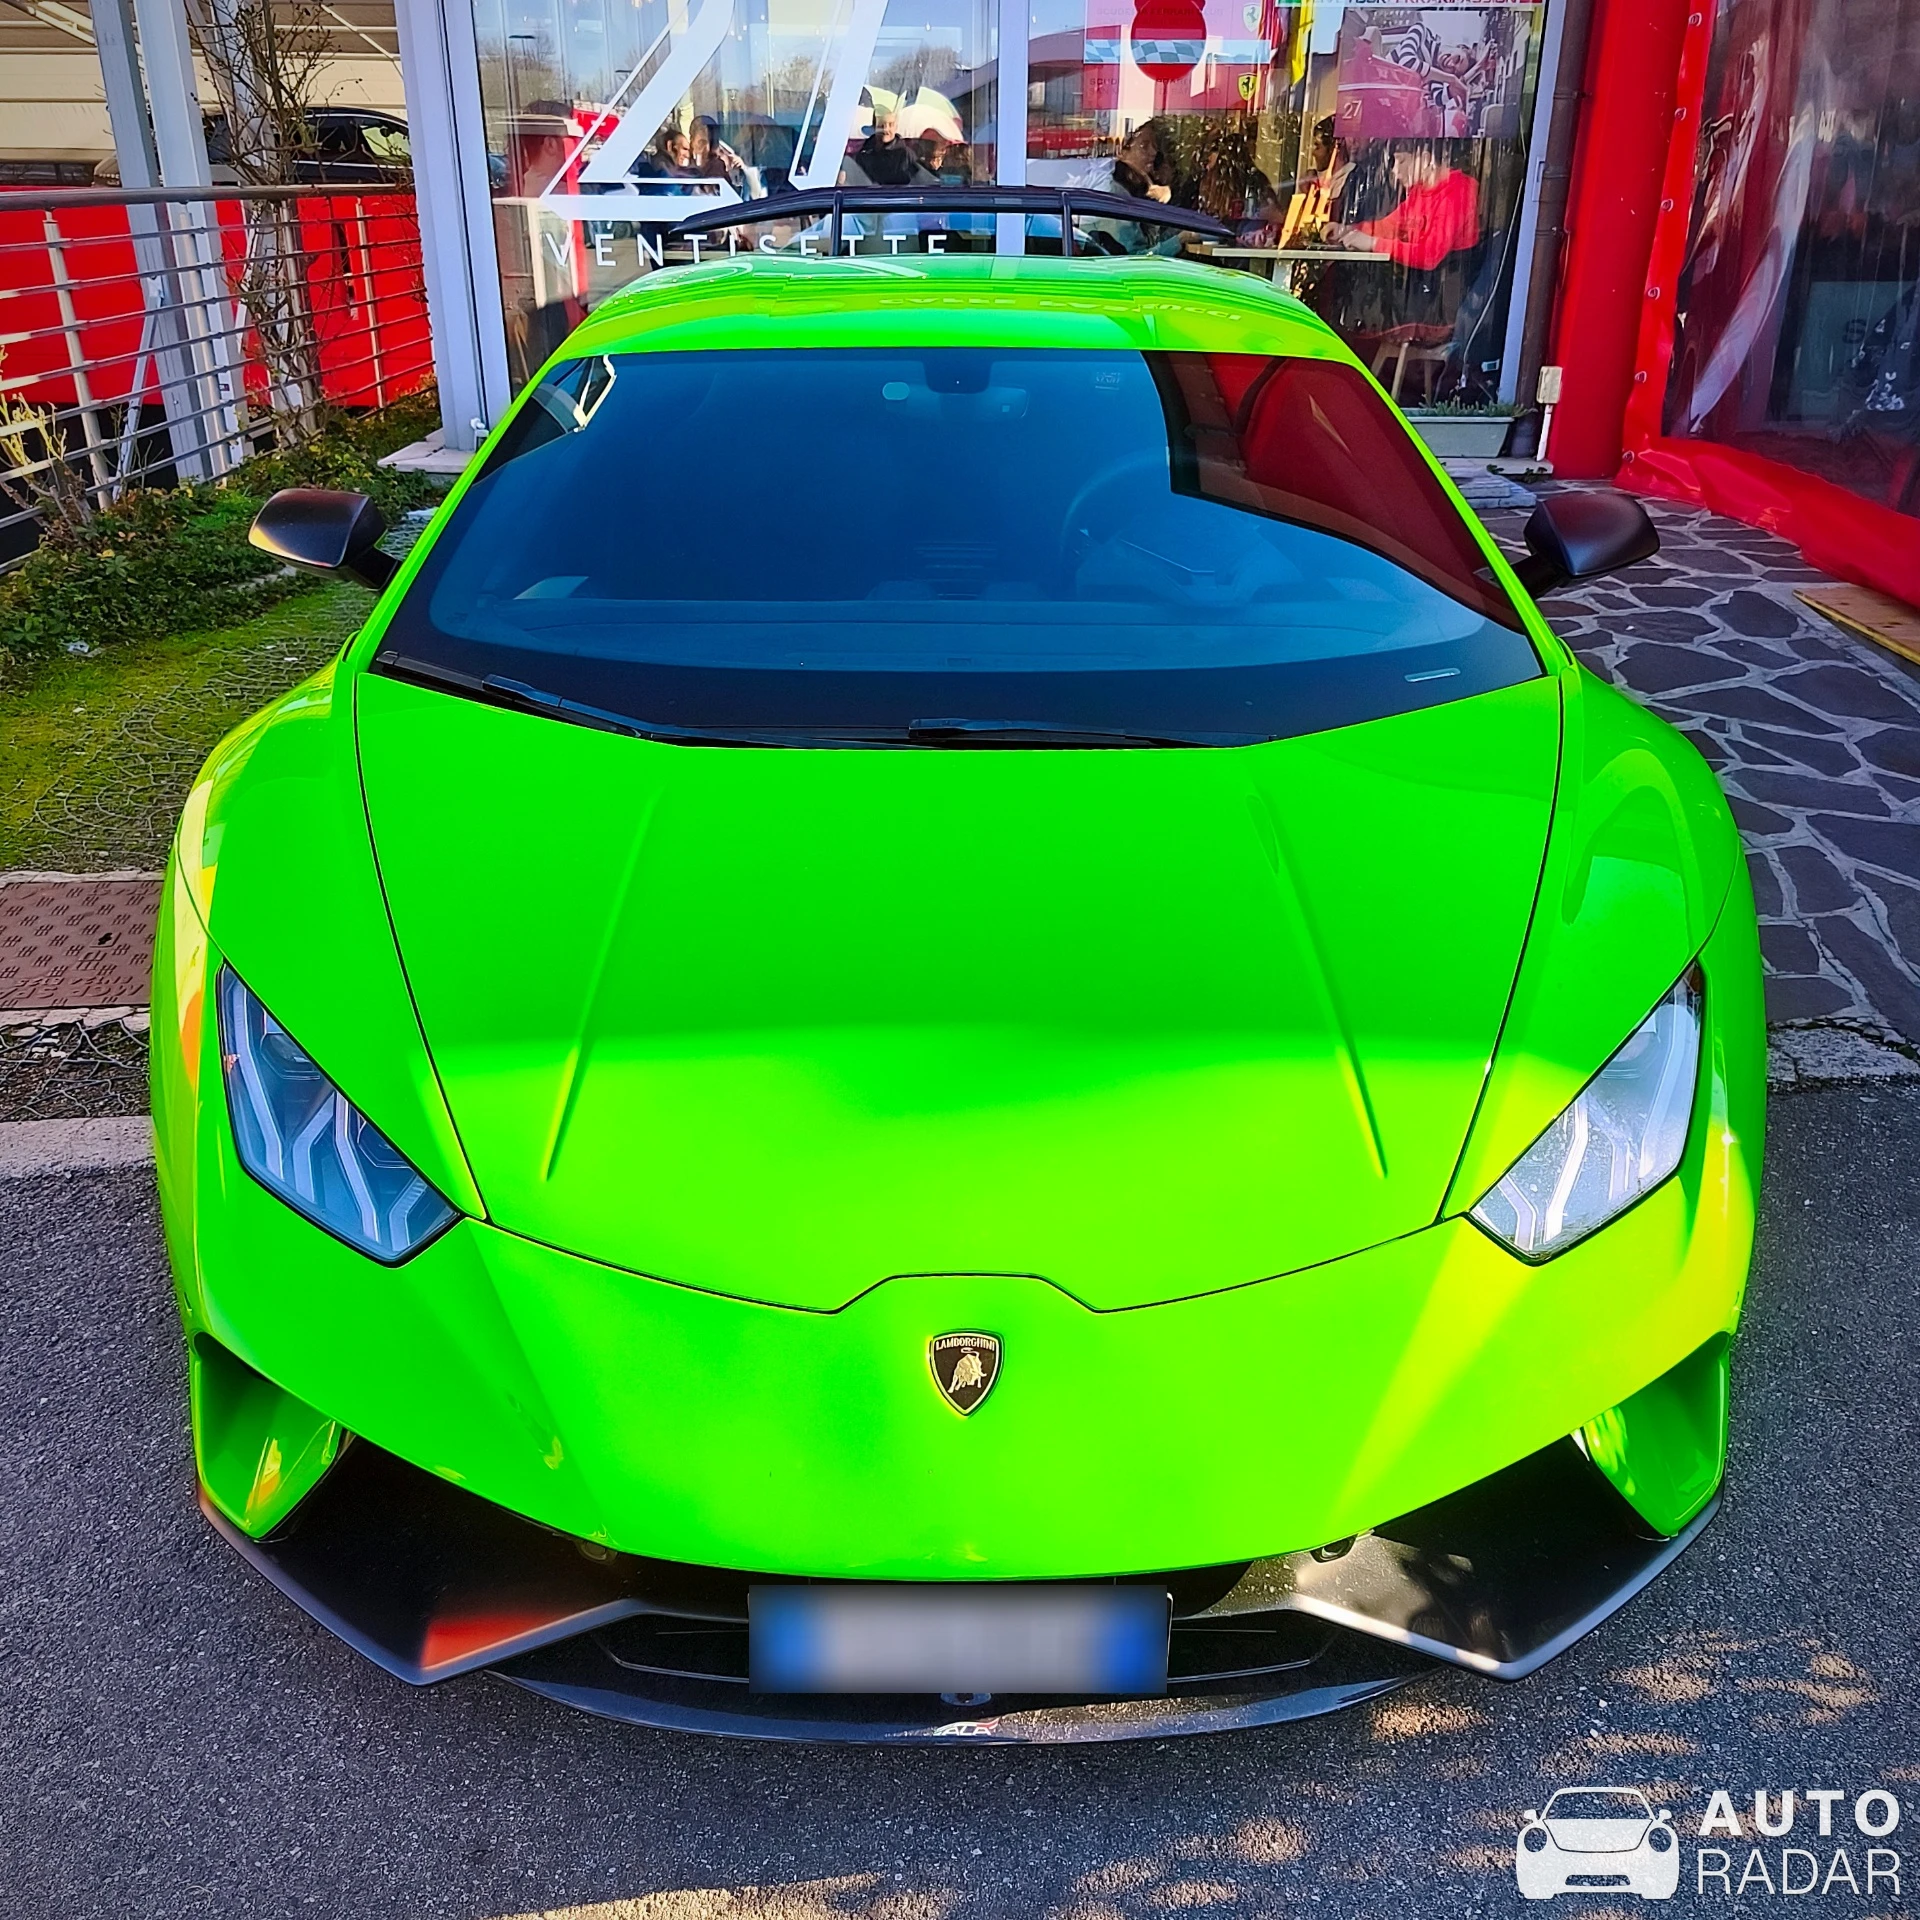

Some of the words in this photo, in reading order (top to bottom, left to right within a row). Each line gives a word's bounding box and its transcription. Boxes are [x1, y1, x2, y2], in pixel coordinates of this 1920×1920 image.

[1342, 100, 1362, 119] 27
[545, 233, 948, 268] VENTISETTE
[935, 1337, 995, 1351] LAMBORGHINI
